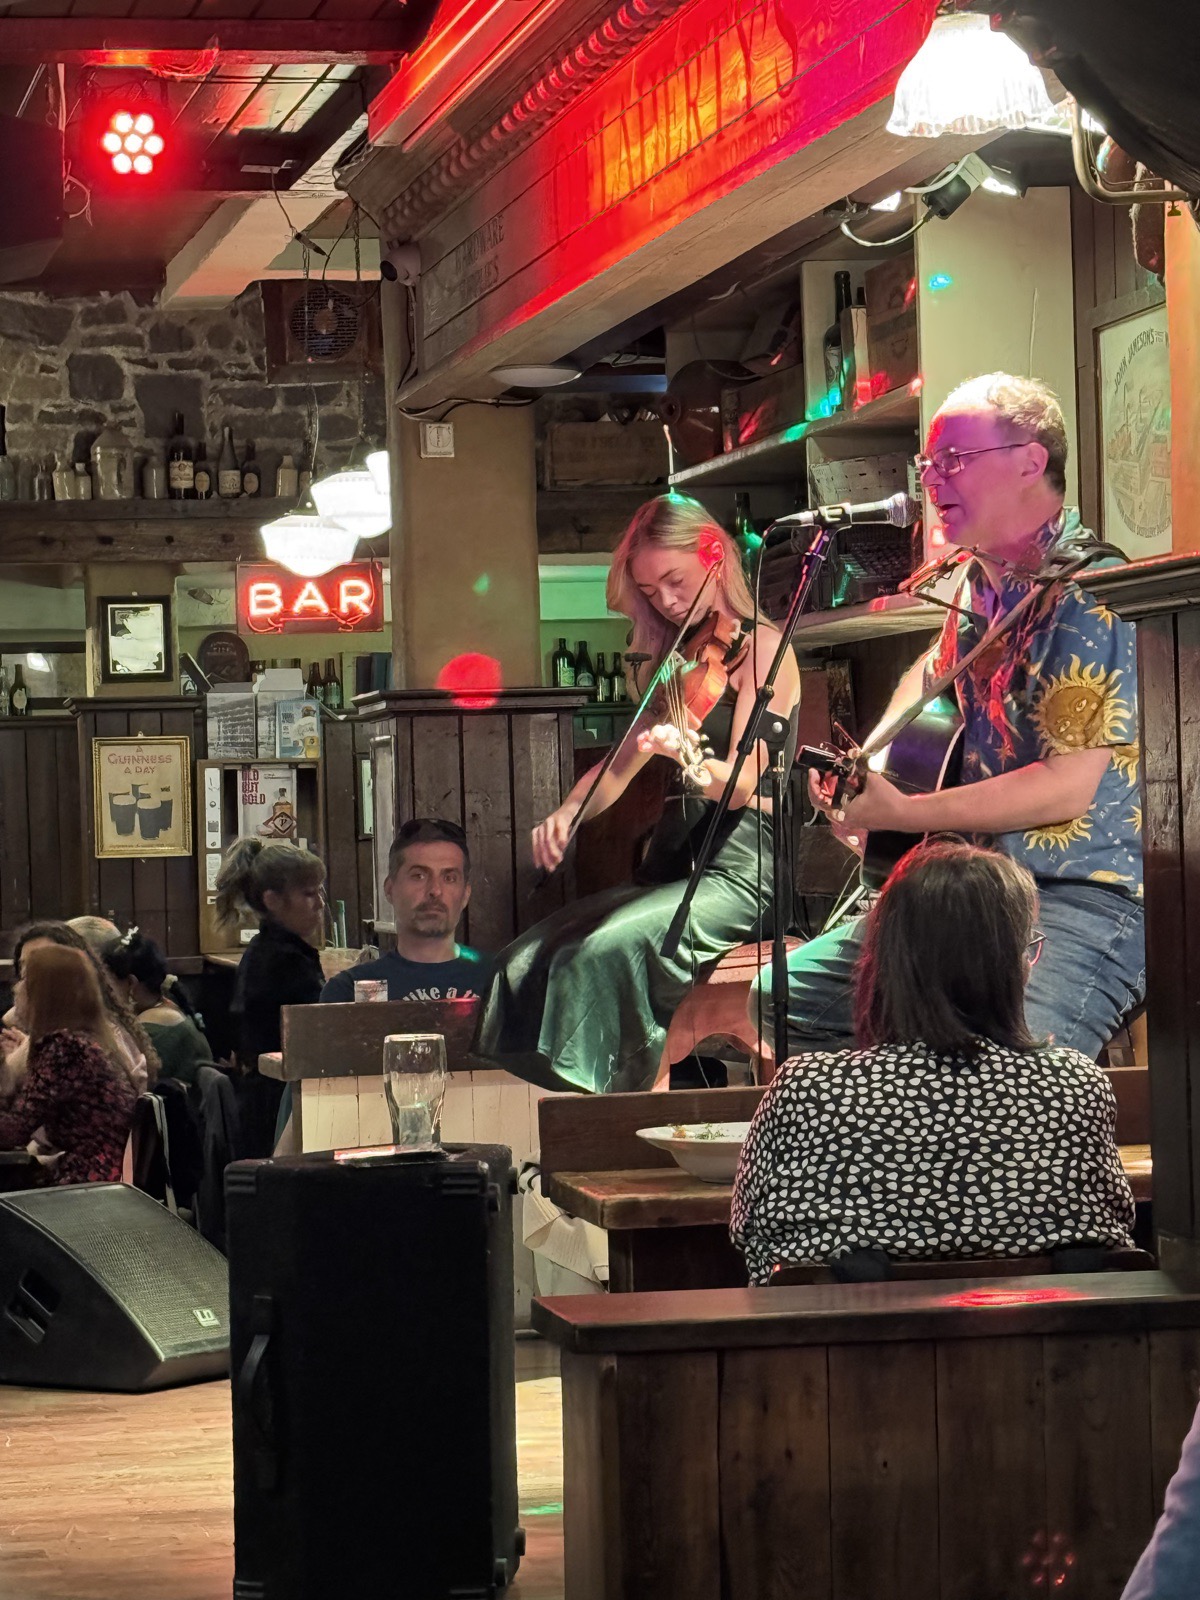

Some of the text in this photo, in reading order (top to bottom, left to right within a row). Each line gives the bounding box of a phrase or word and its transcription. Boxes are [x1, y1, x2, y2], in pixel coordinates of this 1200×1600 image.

[249, 579, 372, 616] BAR
[108, 753, 173, 764] GUINNESS
[124, 766, 156, 774] A DAY
[242, 781, 259, 793] BUT
[242, 793, 266, 805] GOLD
[445, 986, 458, 999] a
